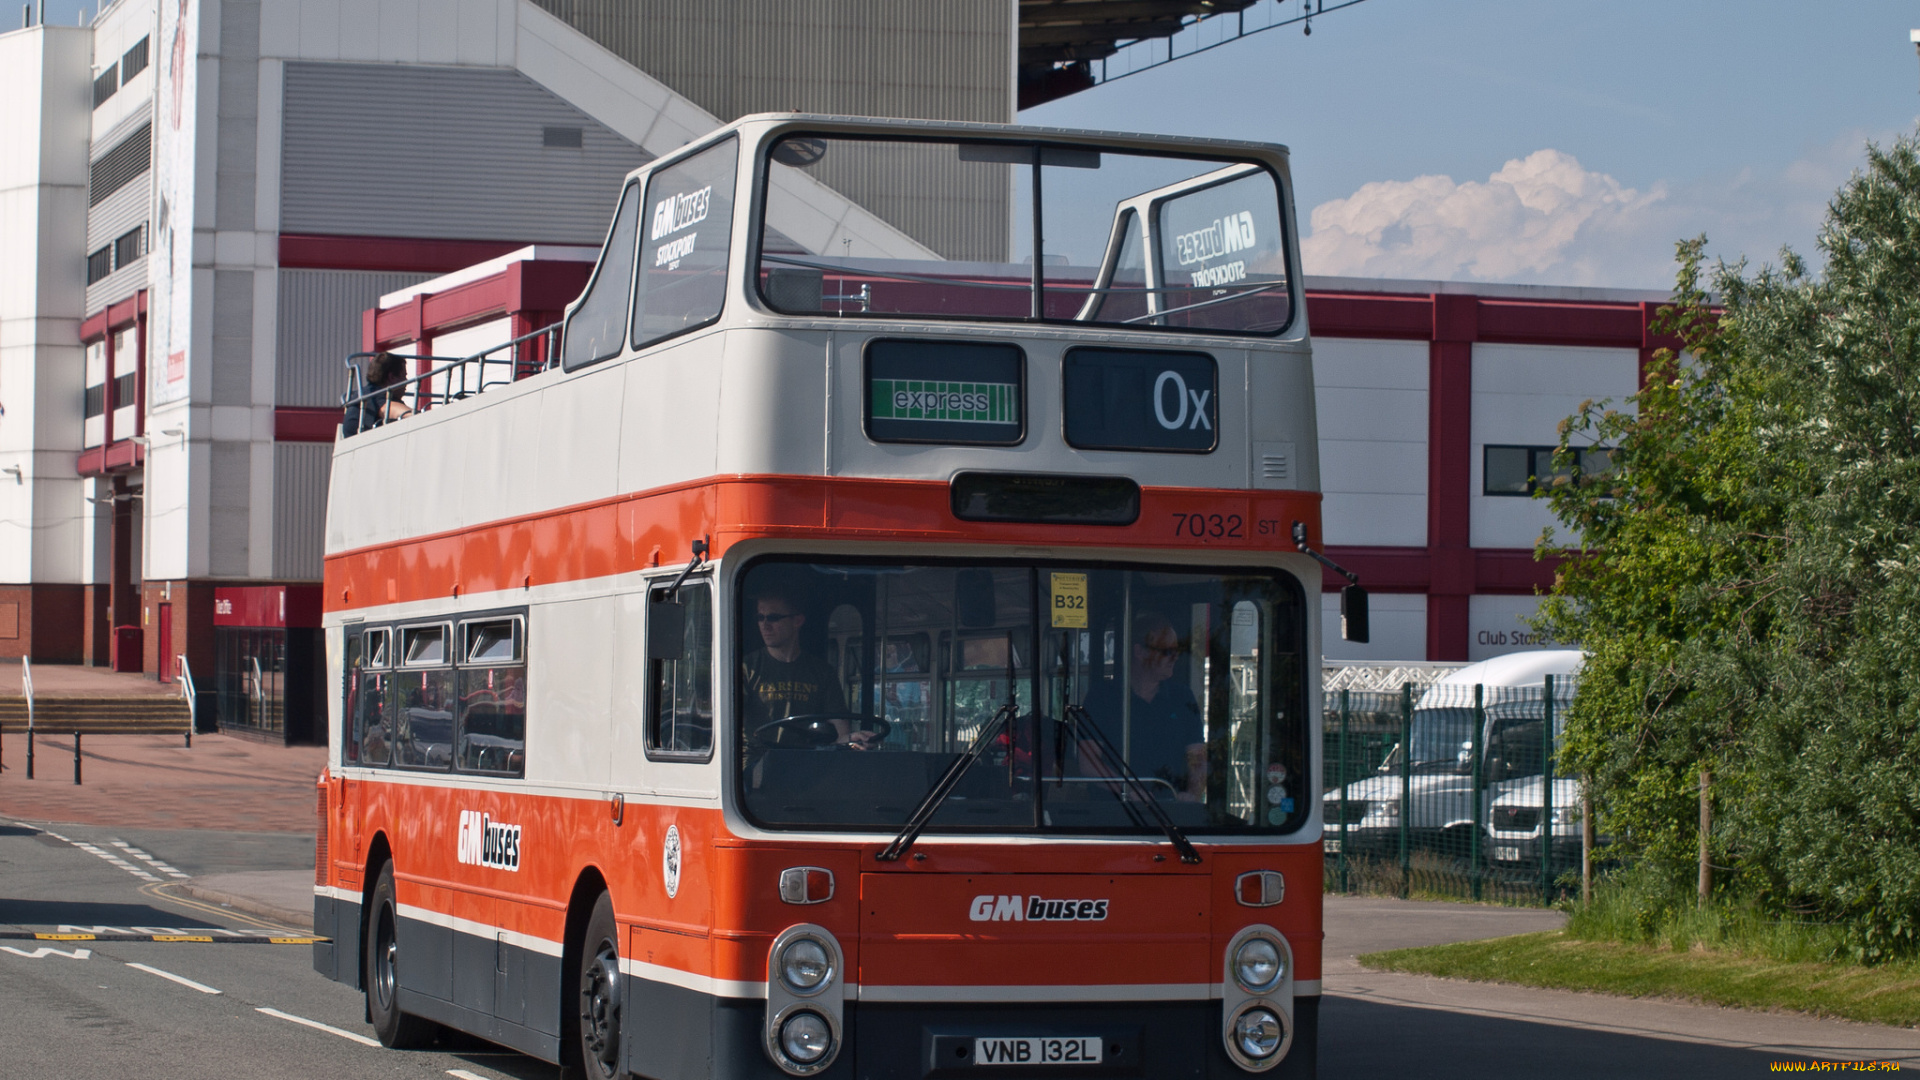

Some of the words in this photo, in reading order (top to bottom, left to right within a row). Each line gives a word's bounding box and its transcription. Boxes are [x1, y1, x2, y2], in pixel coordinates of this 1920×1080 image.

[651, 195, 676, 241] GM
[673, 185, 712, 232] buses
[655, 231, 697, 267] STOCKPORT
[894, 389, 989, 414] express
[1172, 513, 1243, 538] 7032
[1258, 519, 1279, 535] ST
[1055, 594, 1084, 609] B32
[1477, 630, 1507, 646] Club
[457, 809, 481, 866] GM
[481, 812, 522, 873] buses
[969, 895, 1024, 922] GM
[1025, 895, 1110, 922] buses
[982, 1040, 1031, 1062] VNB
[1041, 1039, 1097, 1062] 132L
